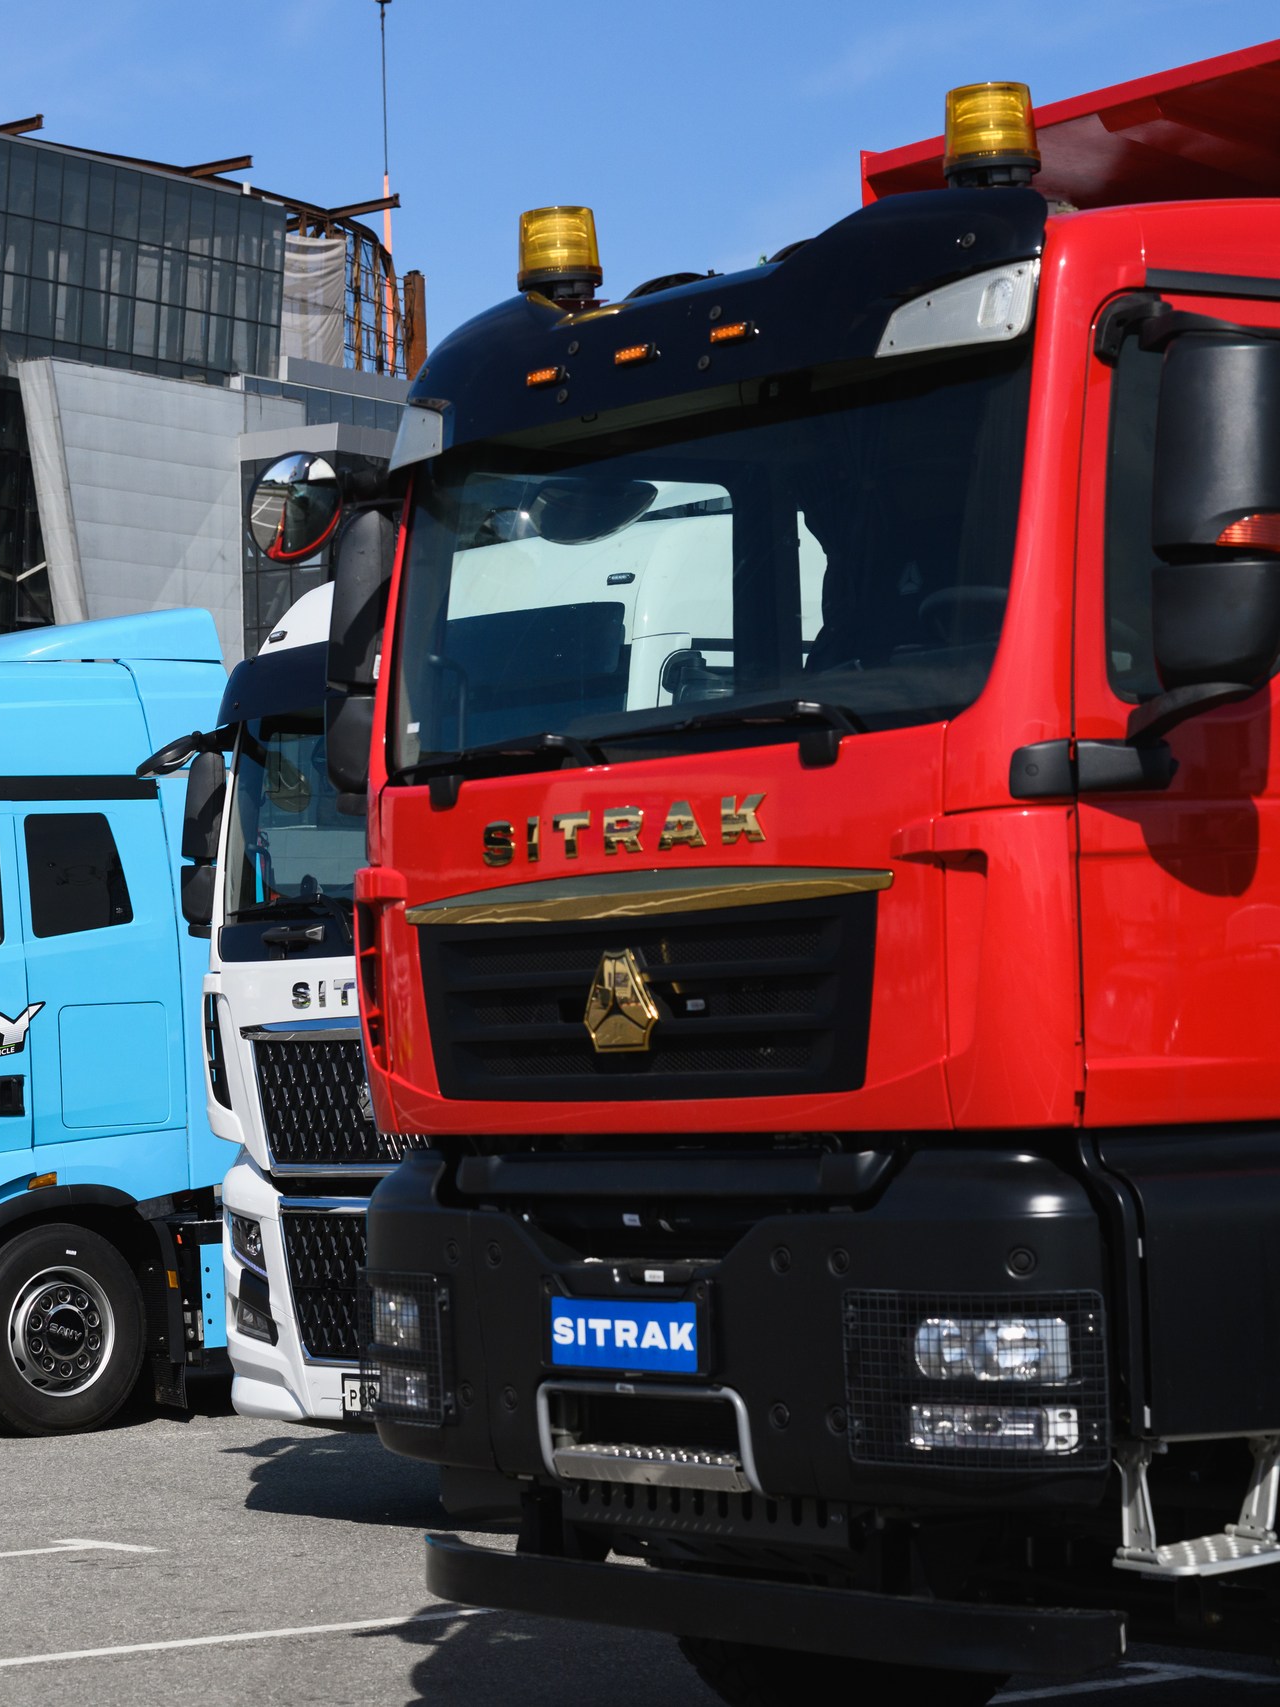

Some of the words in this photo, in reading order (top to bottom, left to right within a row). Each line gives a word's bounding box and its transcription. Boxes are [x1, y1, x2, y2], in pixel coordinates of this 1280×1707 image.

[483, 792, 767, 867] SITRAK
[291, 978, 356, 1009] SIT
[49, 1322, 83, 1342] SANY
[552, 1316, 695, 1352] SITRAK
